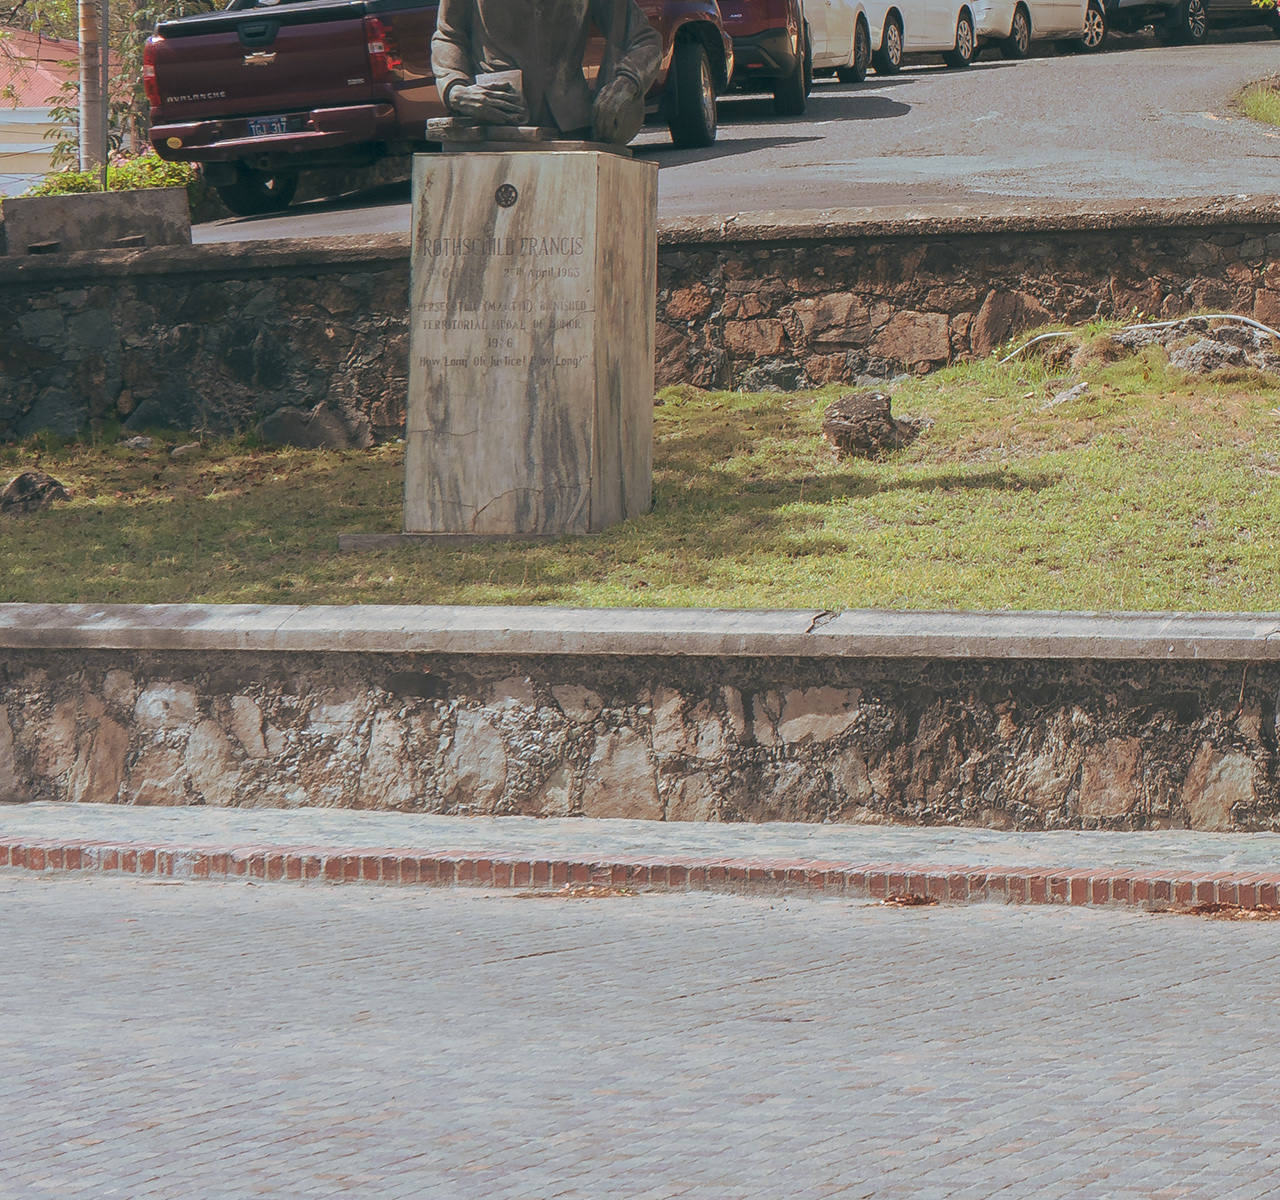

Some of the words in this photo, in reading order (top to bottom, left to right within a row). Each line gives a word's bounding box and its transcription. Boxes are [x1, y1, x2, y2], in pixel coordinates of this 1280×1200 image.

[166, 91, 226, 103] AVALANCHE
[250, 124, 267, 136] TGJ
[271, 122, 287, 134] 317
[423, 237, 515, 257] ROTHSCHILD
[520, 237, 584, 257] FRANCIS
[527, 266, 554, 280] April
[556, 267, 580, 278] 1963
[422, 319, 488, 331] TERRITORIAL
[491, 319, 526, 331] MEDAL
[533, 319, 545, 330] OF
[444, 356, 468, 368] Long
[473, 356, 486, 367] Oh
